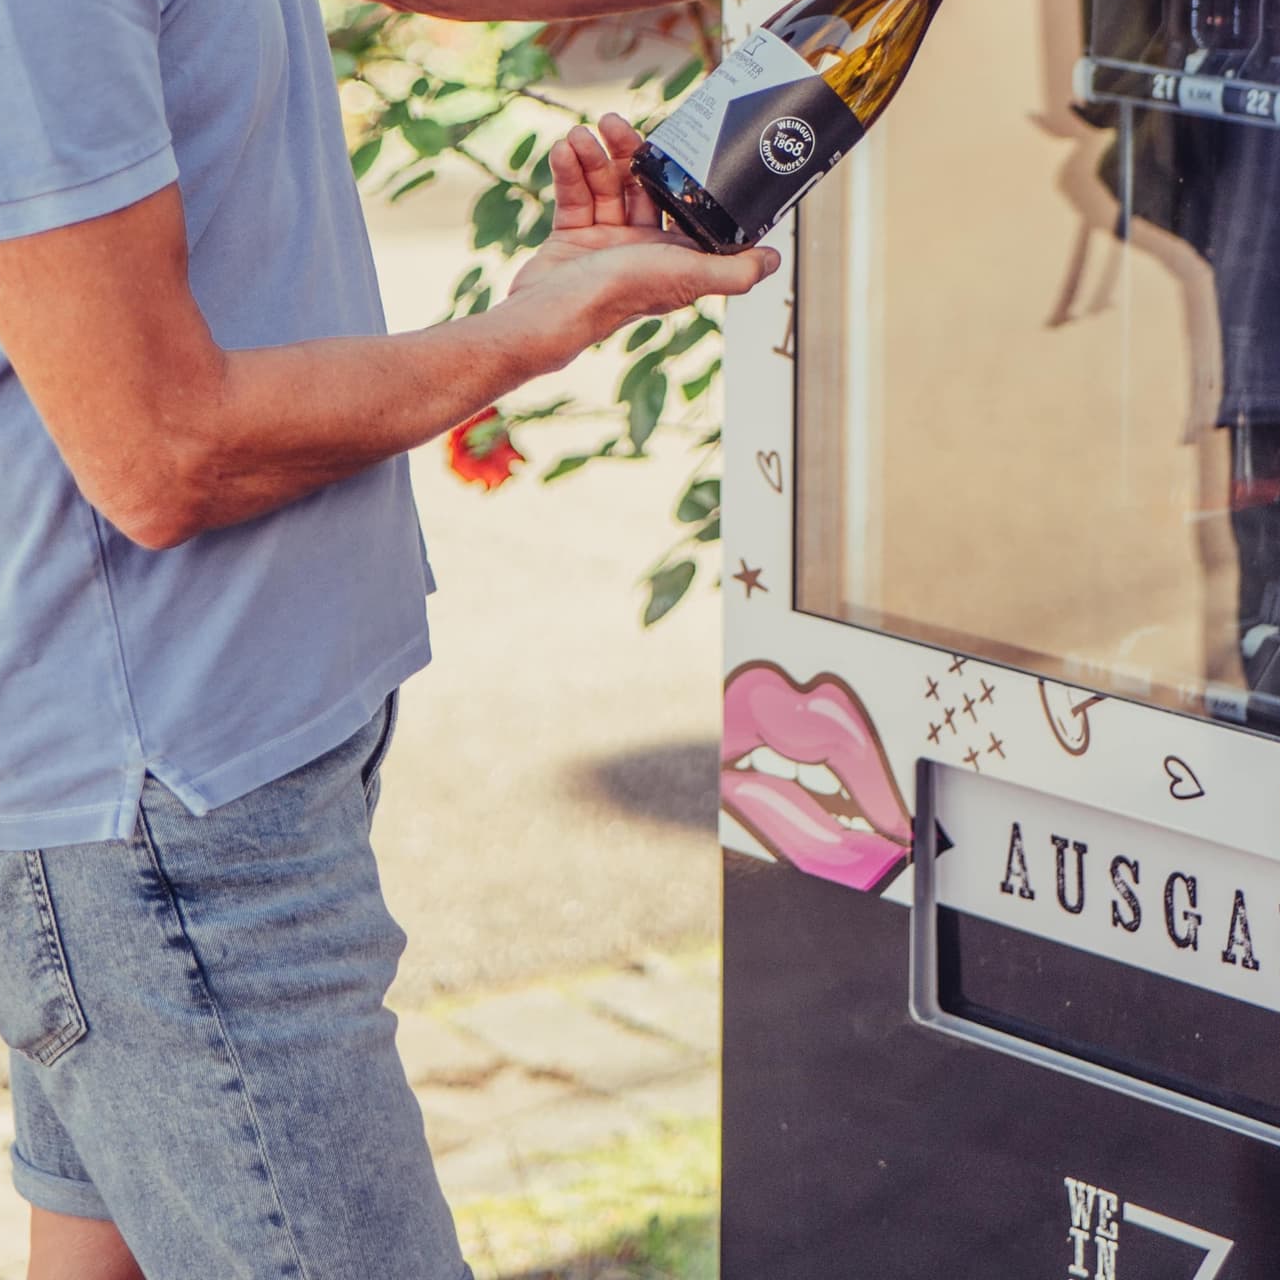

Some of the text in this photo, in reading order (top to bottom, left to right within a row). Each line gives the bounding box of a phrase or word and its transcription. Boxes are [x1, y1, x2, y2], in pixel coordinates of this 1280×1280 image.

[1151, 73, 1176, 100] 21
[1246, 88, 1270, 115] 22
[776, 119, 812, 142] WEINGUT
[763, 140, 806, 173] KOPPENHÖFER
[773, 136, 805, 157] 1868
